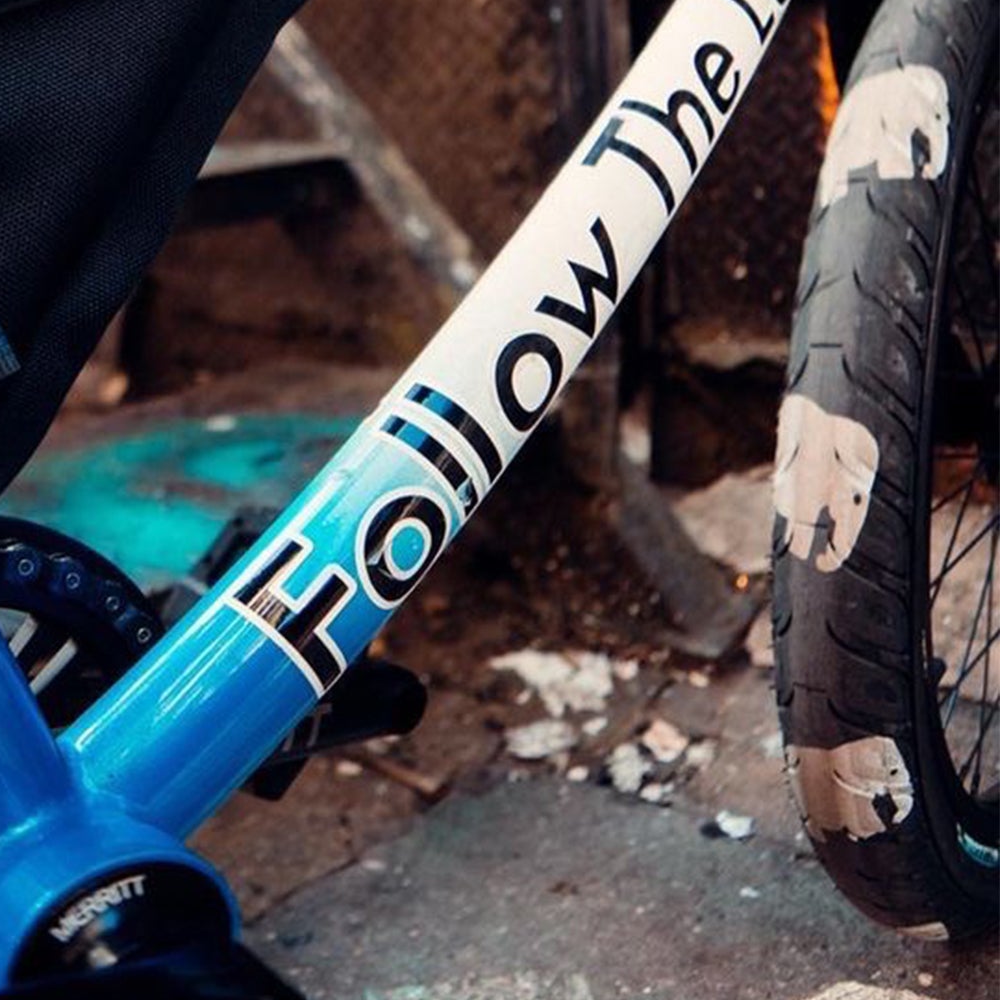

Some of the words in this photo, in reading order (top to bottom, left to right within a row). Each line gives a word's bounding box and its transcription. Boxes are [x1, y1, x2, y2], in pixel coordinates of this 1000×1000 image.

[223, 216, 619, 698] Follow
[582, 41, 740, 216] The
[50, 874, 147, 943] MERRITT
